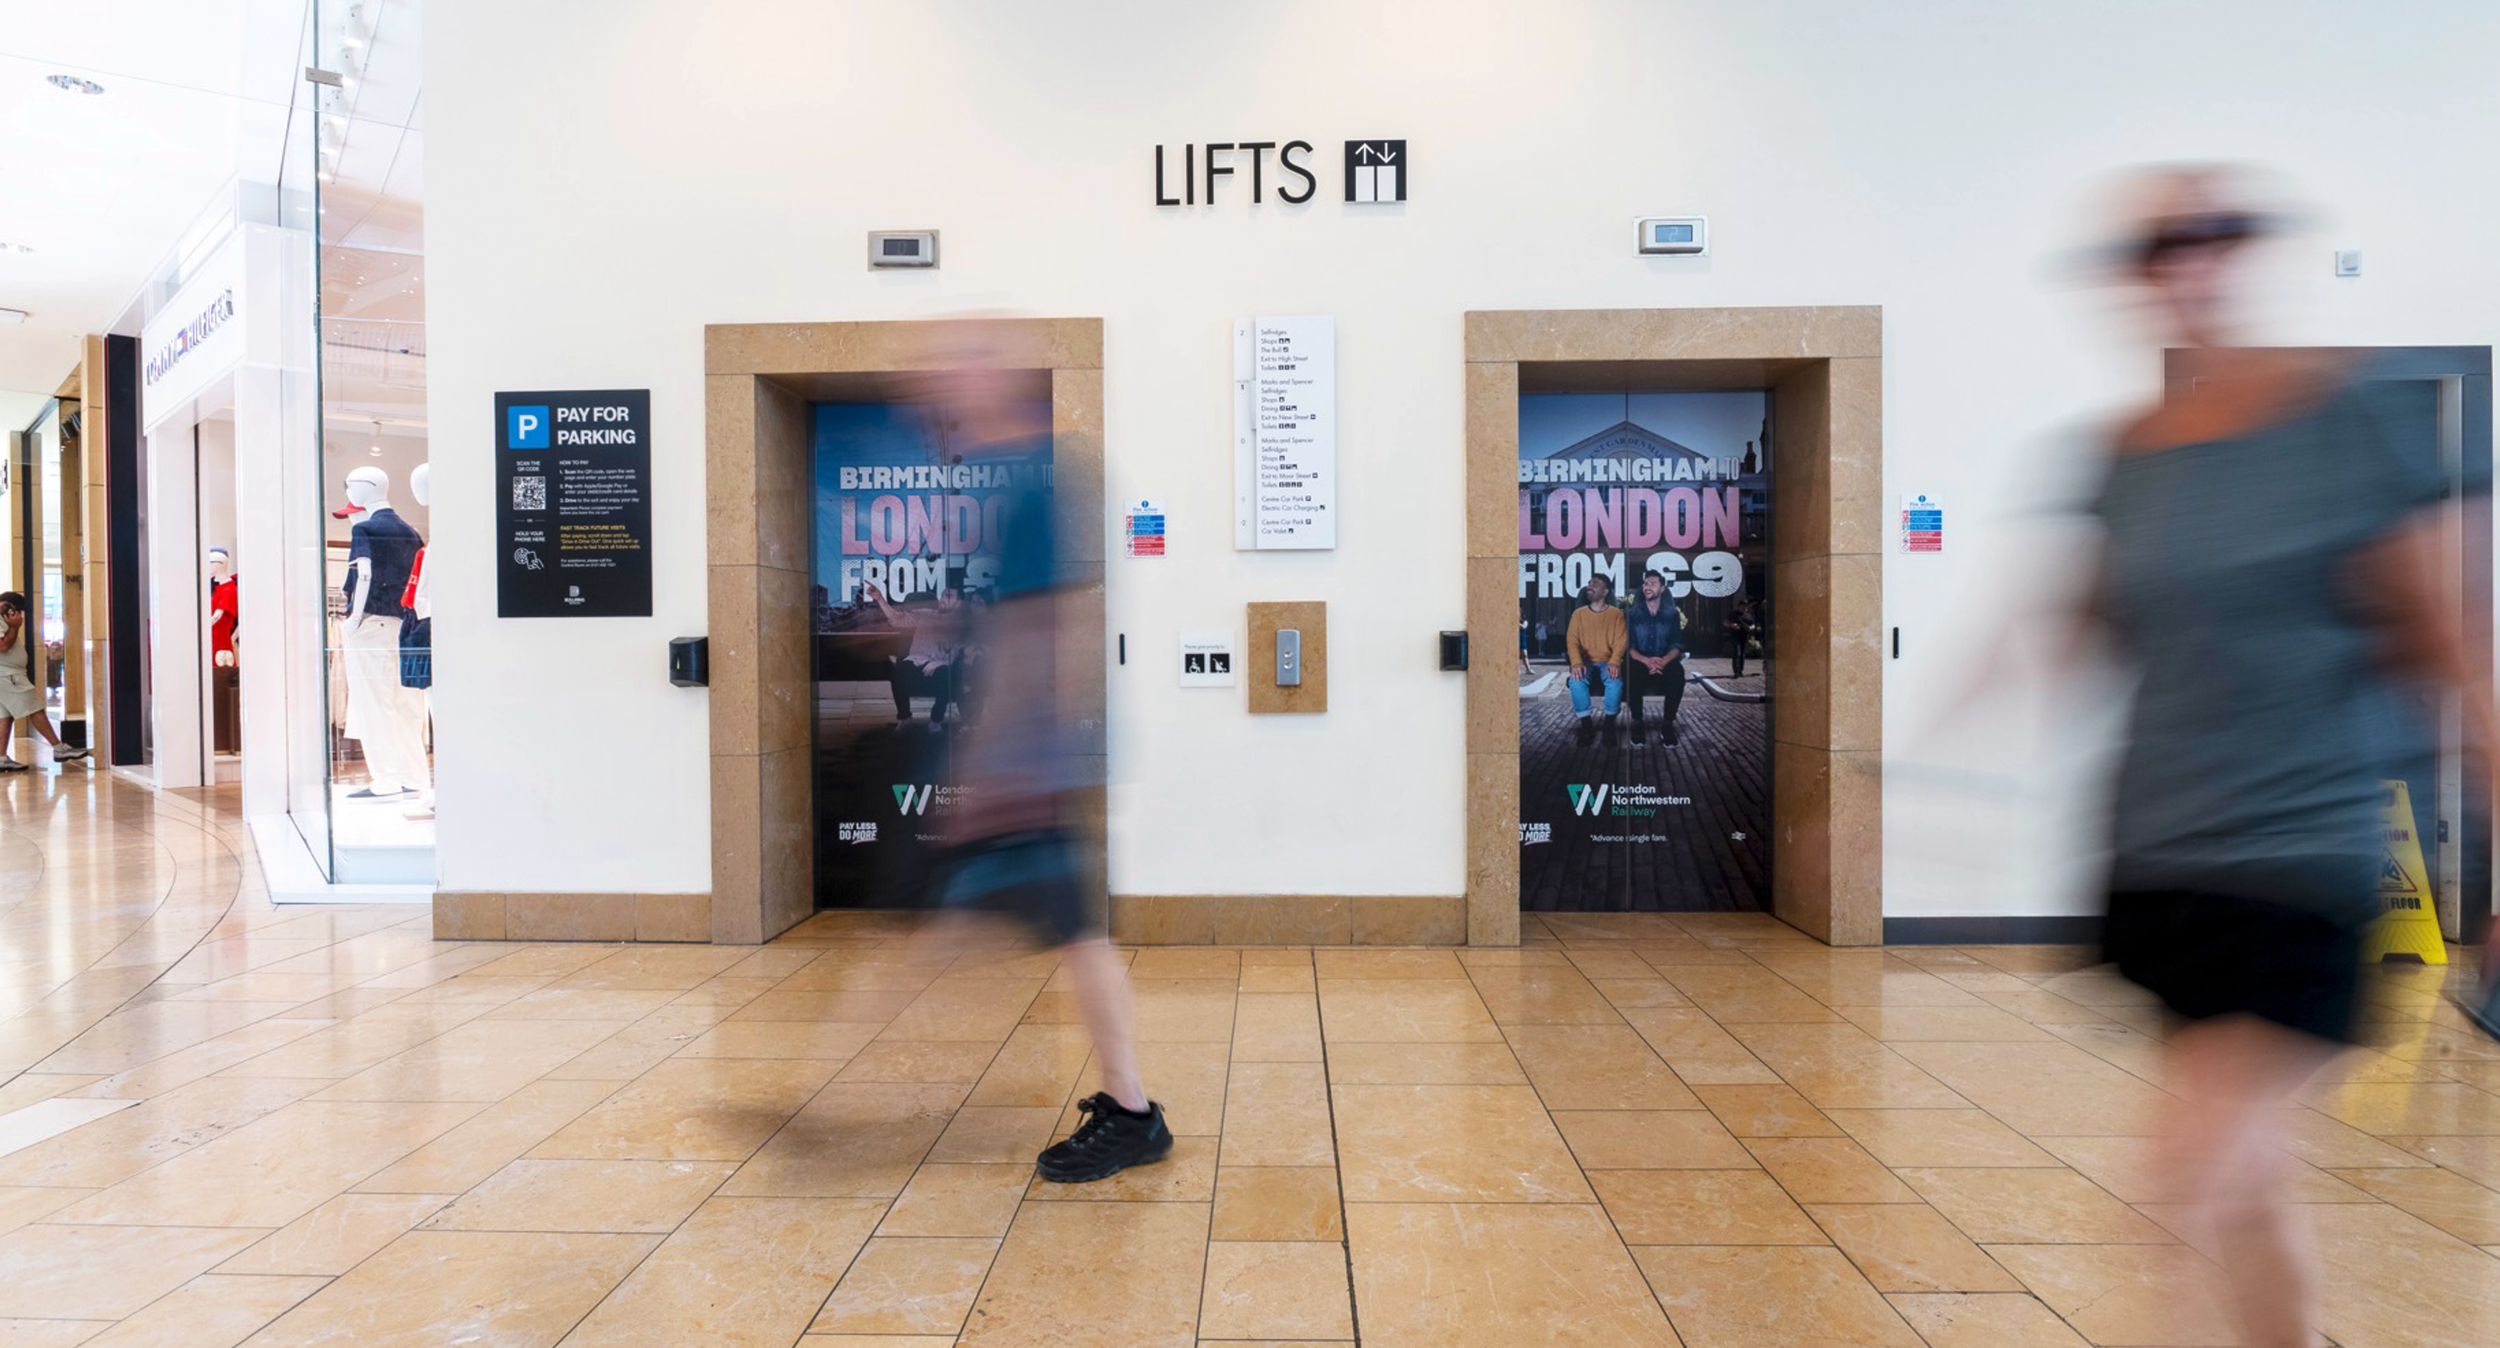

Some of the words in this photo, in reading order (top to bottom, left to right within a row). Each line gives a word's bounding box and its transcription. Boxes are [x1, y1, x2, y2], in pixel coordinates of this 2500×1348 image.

[1154, 141, 1316, 207] LIFTS
[557, 408, 590, 422] PAY
[593, 407, 629, 421] FOR
[518, 415, 538, 439] P
[558, 430, 636, 445] PARKING
[1606, 438, 1646, 448] GARDEN
[1519, 458, 1717, 482] BIRMINGHAM
[1724, 457, 1739, 480] TO
[1519, 488, 1740, 550] LONDON
[840, 495, 1012, 556] LONDO
[840, 558, 946, 602] FROM
[1519, 553, 1625, 599] FROM
[1612, 784, 1656, 794] London
[1612, 795, 1691, 805] Northwestern
[1611, 806, 1656, 817] Railway
[1519, 823, 1527, 831] AY
[839, 830, 852, 840] DO
[852, 830, 876, 841] MORE
[1525, 831, 1551, 841] MORE
[1626, 834, 1650, 843] single
[2383, 829, 2409, 841] TION
[2390, 897, 2421, 909] FLOOR
